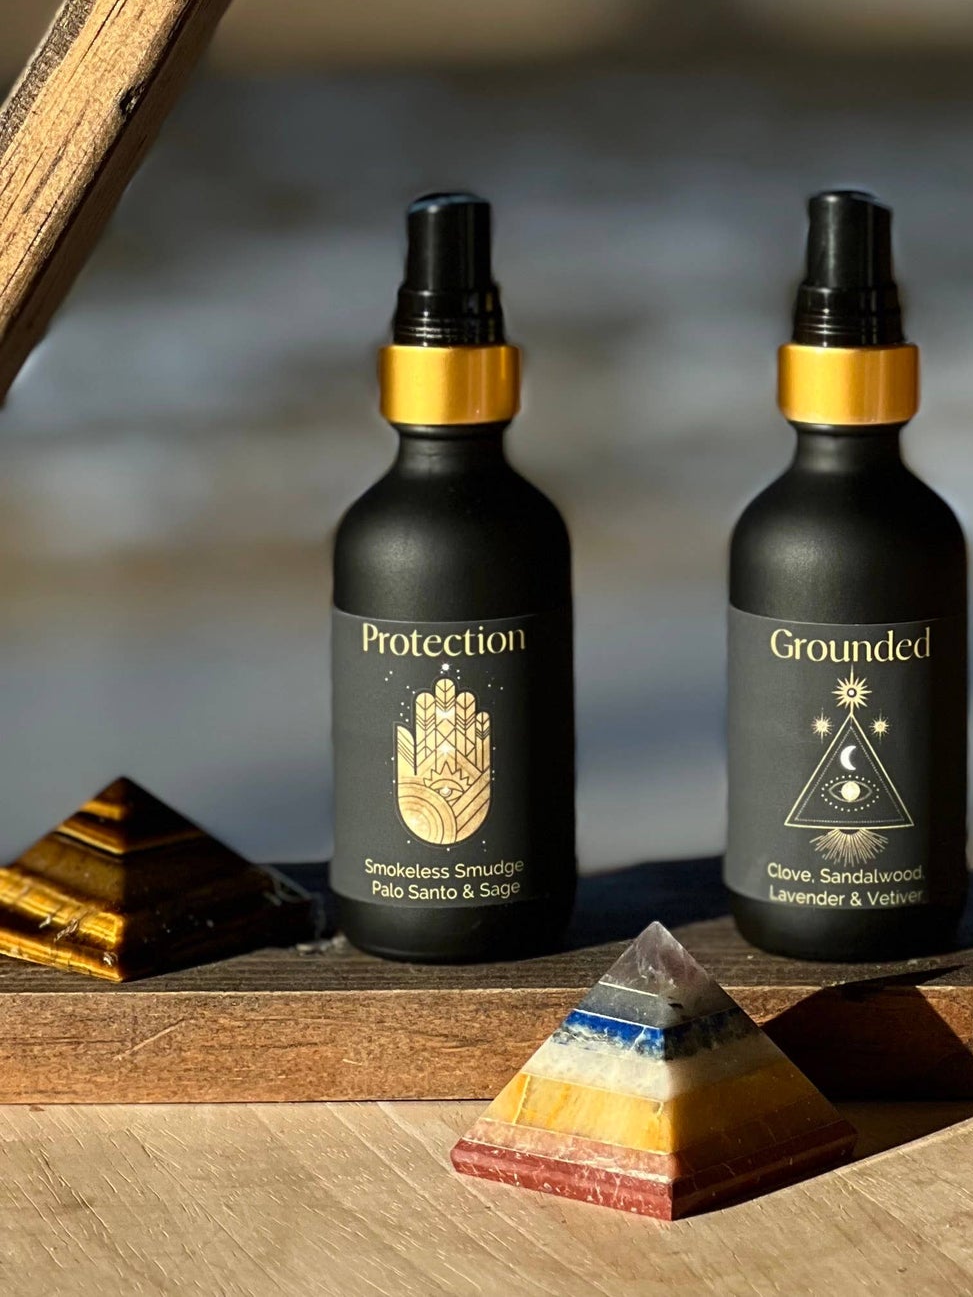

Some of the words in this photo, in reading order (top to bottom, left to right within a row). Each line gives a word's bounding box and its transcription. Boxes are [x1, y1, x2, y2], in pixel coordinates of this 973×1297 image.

[362, 622, 526, 657] Protection
[770, 626, 931, 663] Grounded
[365, 858, 450, 879] Smokeless
[454, 858, 524, 879] Smudge
[767, 862, 815, 883] Clove,
[372, 881, 403, 898] Palo
[408, 885, 456, 900] Santo
[462, 885, 474, 899] &
[479, 881, 521, 899] Sage
[769, 885, 845, 906] Lavender
[850, 892, 862, 907] &
[867, 890, 924, 906] Vetiver
